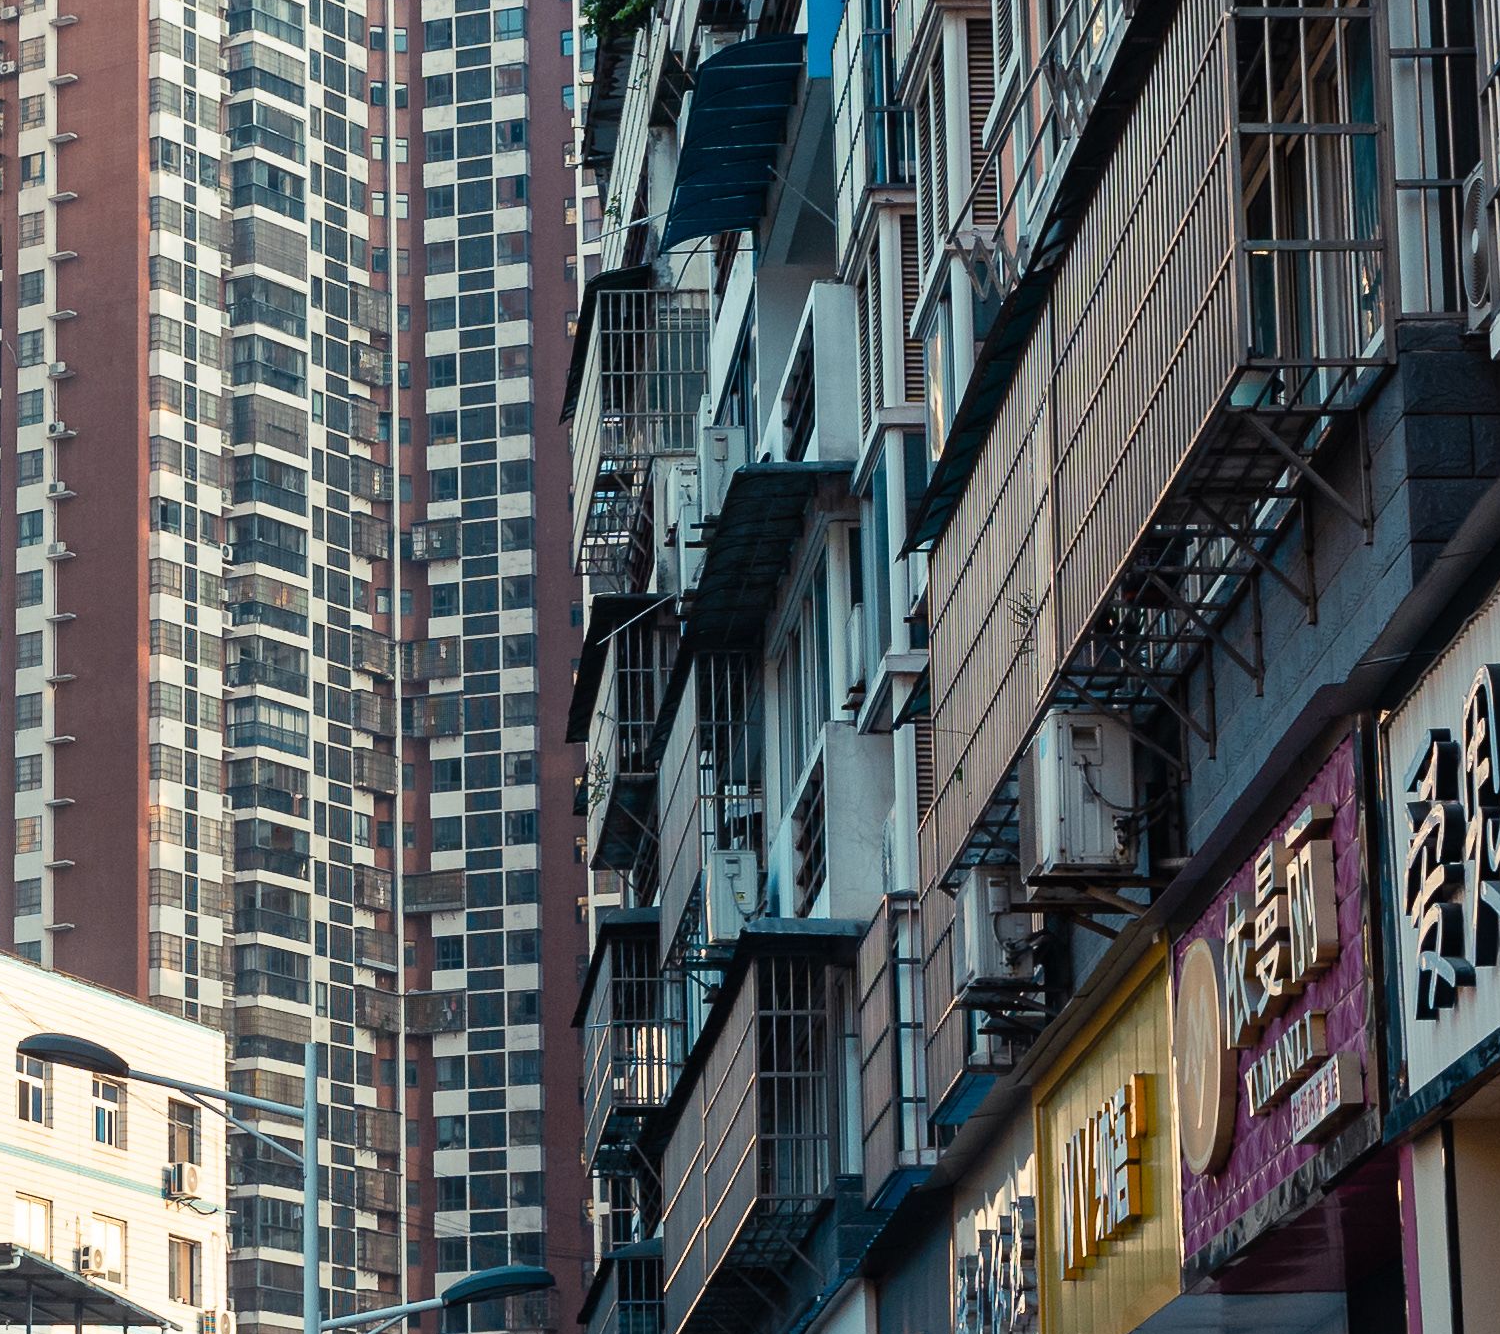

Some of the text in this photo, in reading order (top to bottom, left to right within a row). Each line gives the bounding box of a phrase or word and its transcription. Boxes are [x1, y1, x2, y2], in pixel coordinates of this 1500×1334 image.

[1223, 804, 1328, 1051] 依曼丽
[1244, 1009, 1314, 1118] YIMANLI
